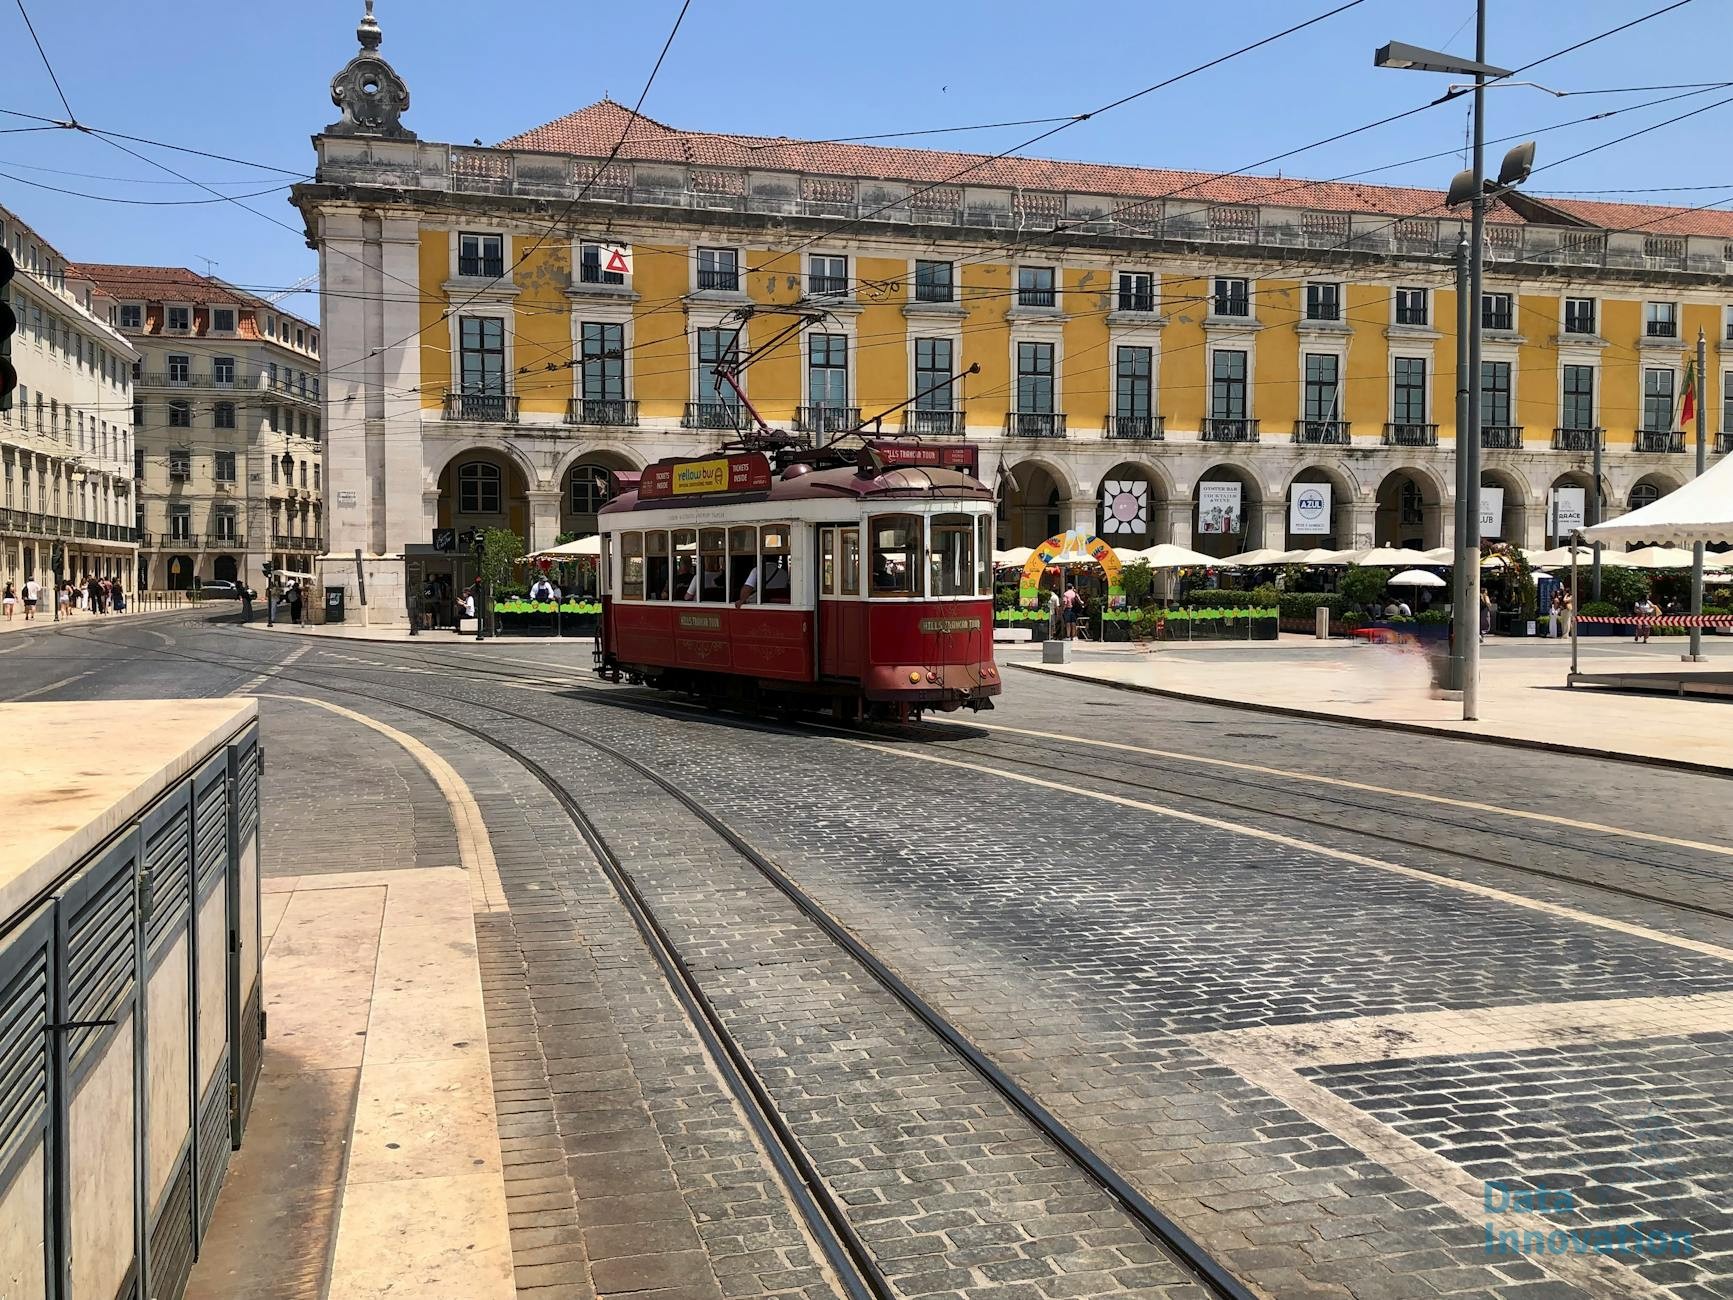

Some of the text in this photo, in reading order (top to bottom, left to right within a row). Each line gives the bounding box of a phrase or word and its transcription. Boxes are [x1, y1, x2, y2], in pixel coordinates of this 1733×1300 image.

[733, 464, 749, 472] TICKETS
[656, 472, 670, 480] TICKETS
[677, 466, 714, 482] yellow bus
[734, 474, 748, 482] INSIDE
[1301, 500, 1322, 509] AZUL
